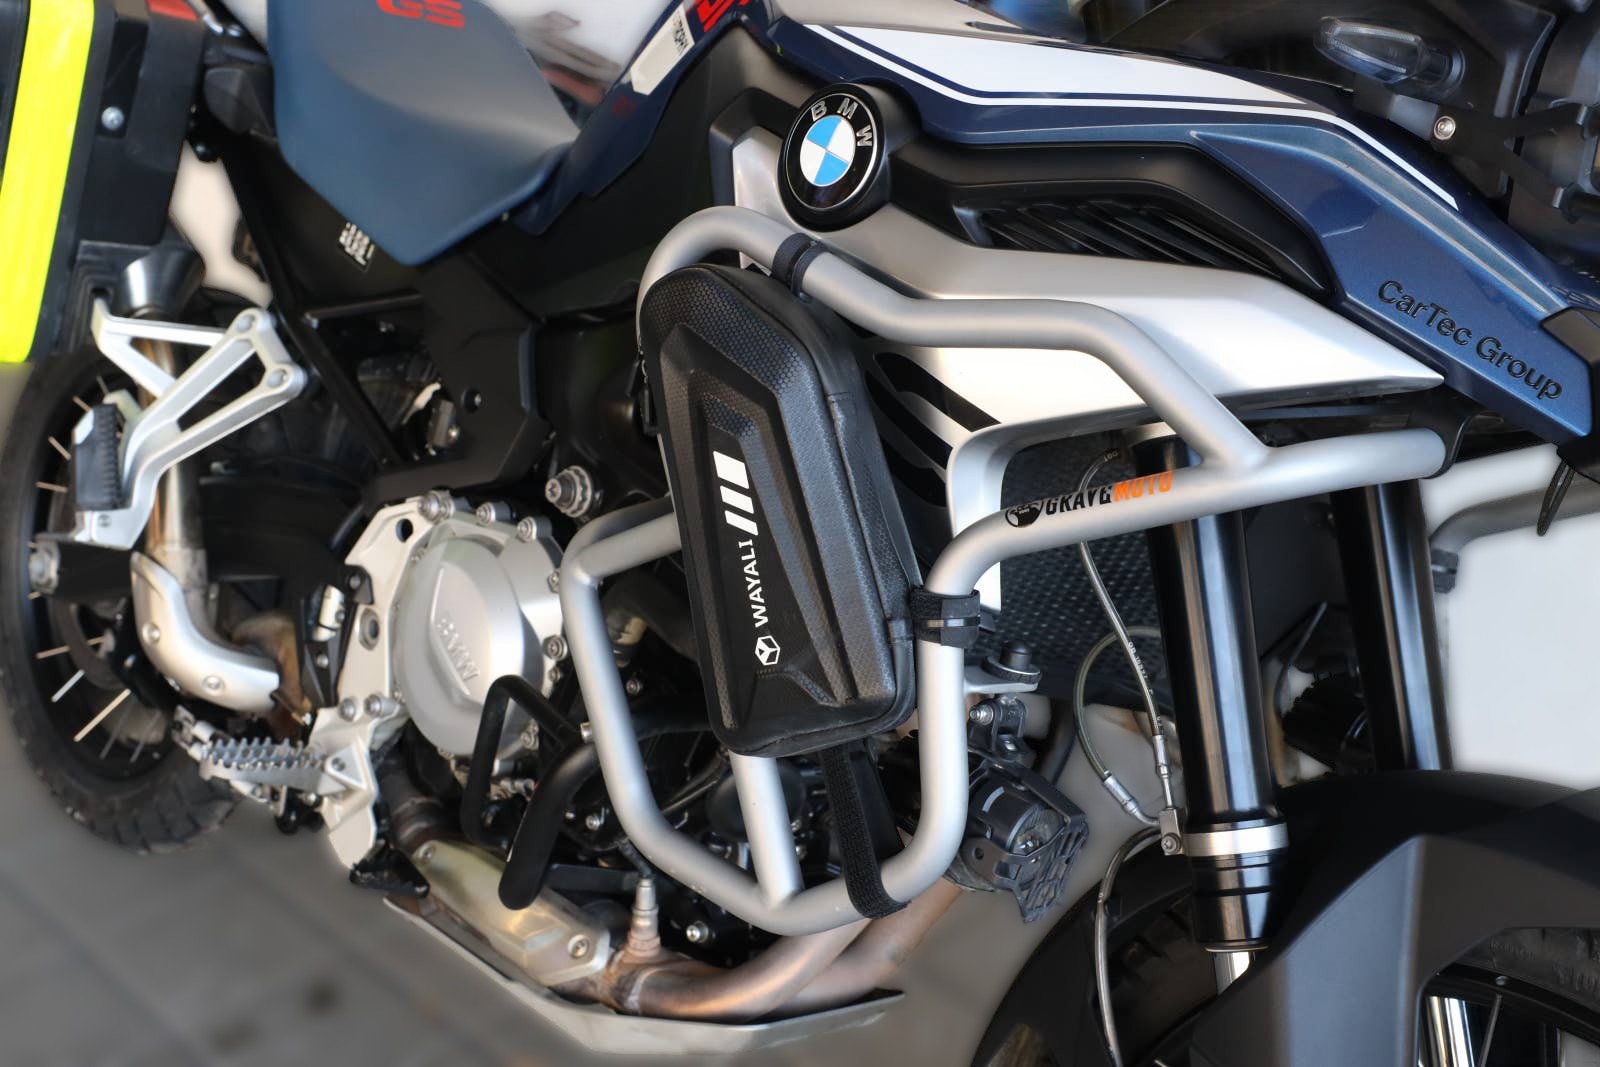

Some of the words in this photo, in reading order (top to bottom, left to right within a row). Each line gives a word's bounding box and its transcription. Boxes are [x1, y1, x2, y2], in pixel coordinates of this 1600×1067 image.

[376, 0, 465, 28] GS
[811, 98, 873, 147] BMW
[1378, 280, 1473, 346] CarTec
[1476, 336, 1563, 399] Group
[738, 539, 769, 628] WAYALI
